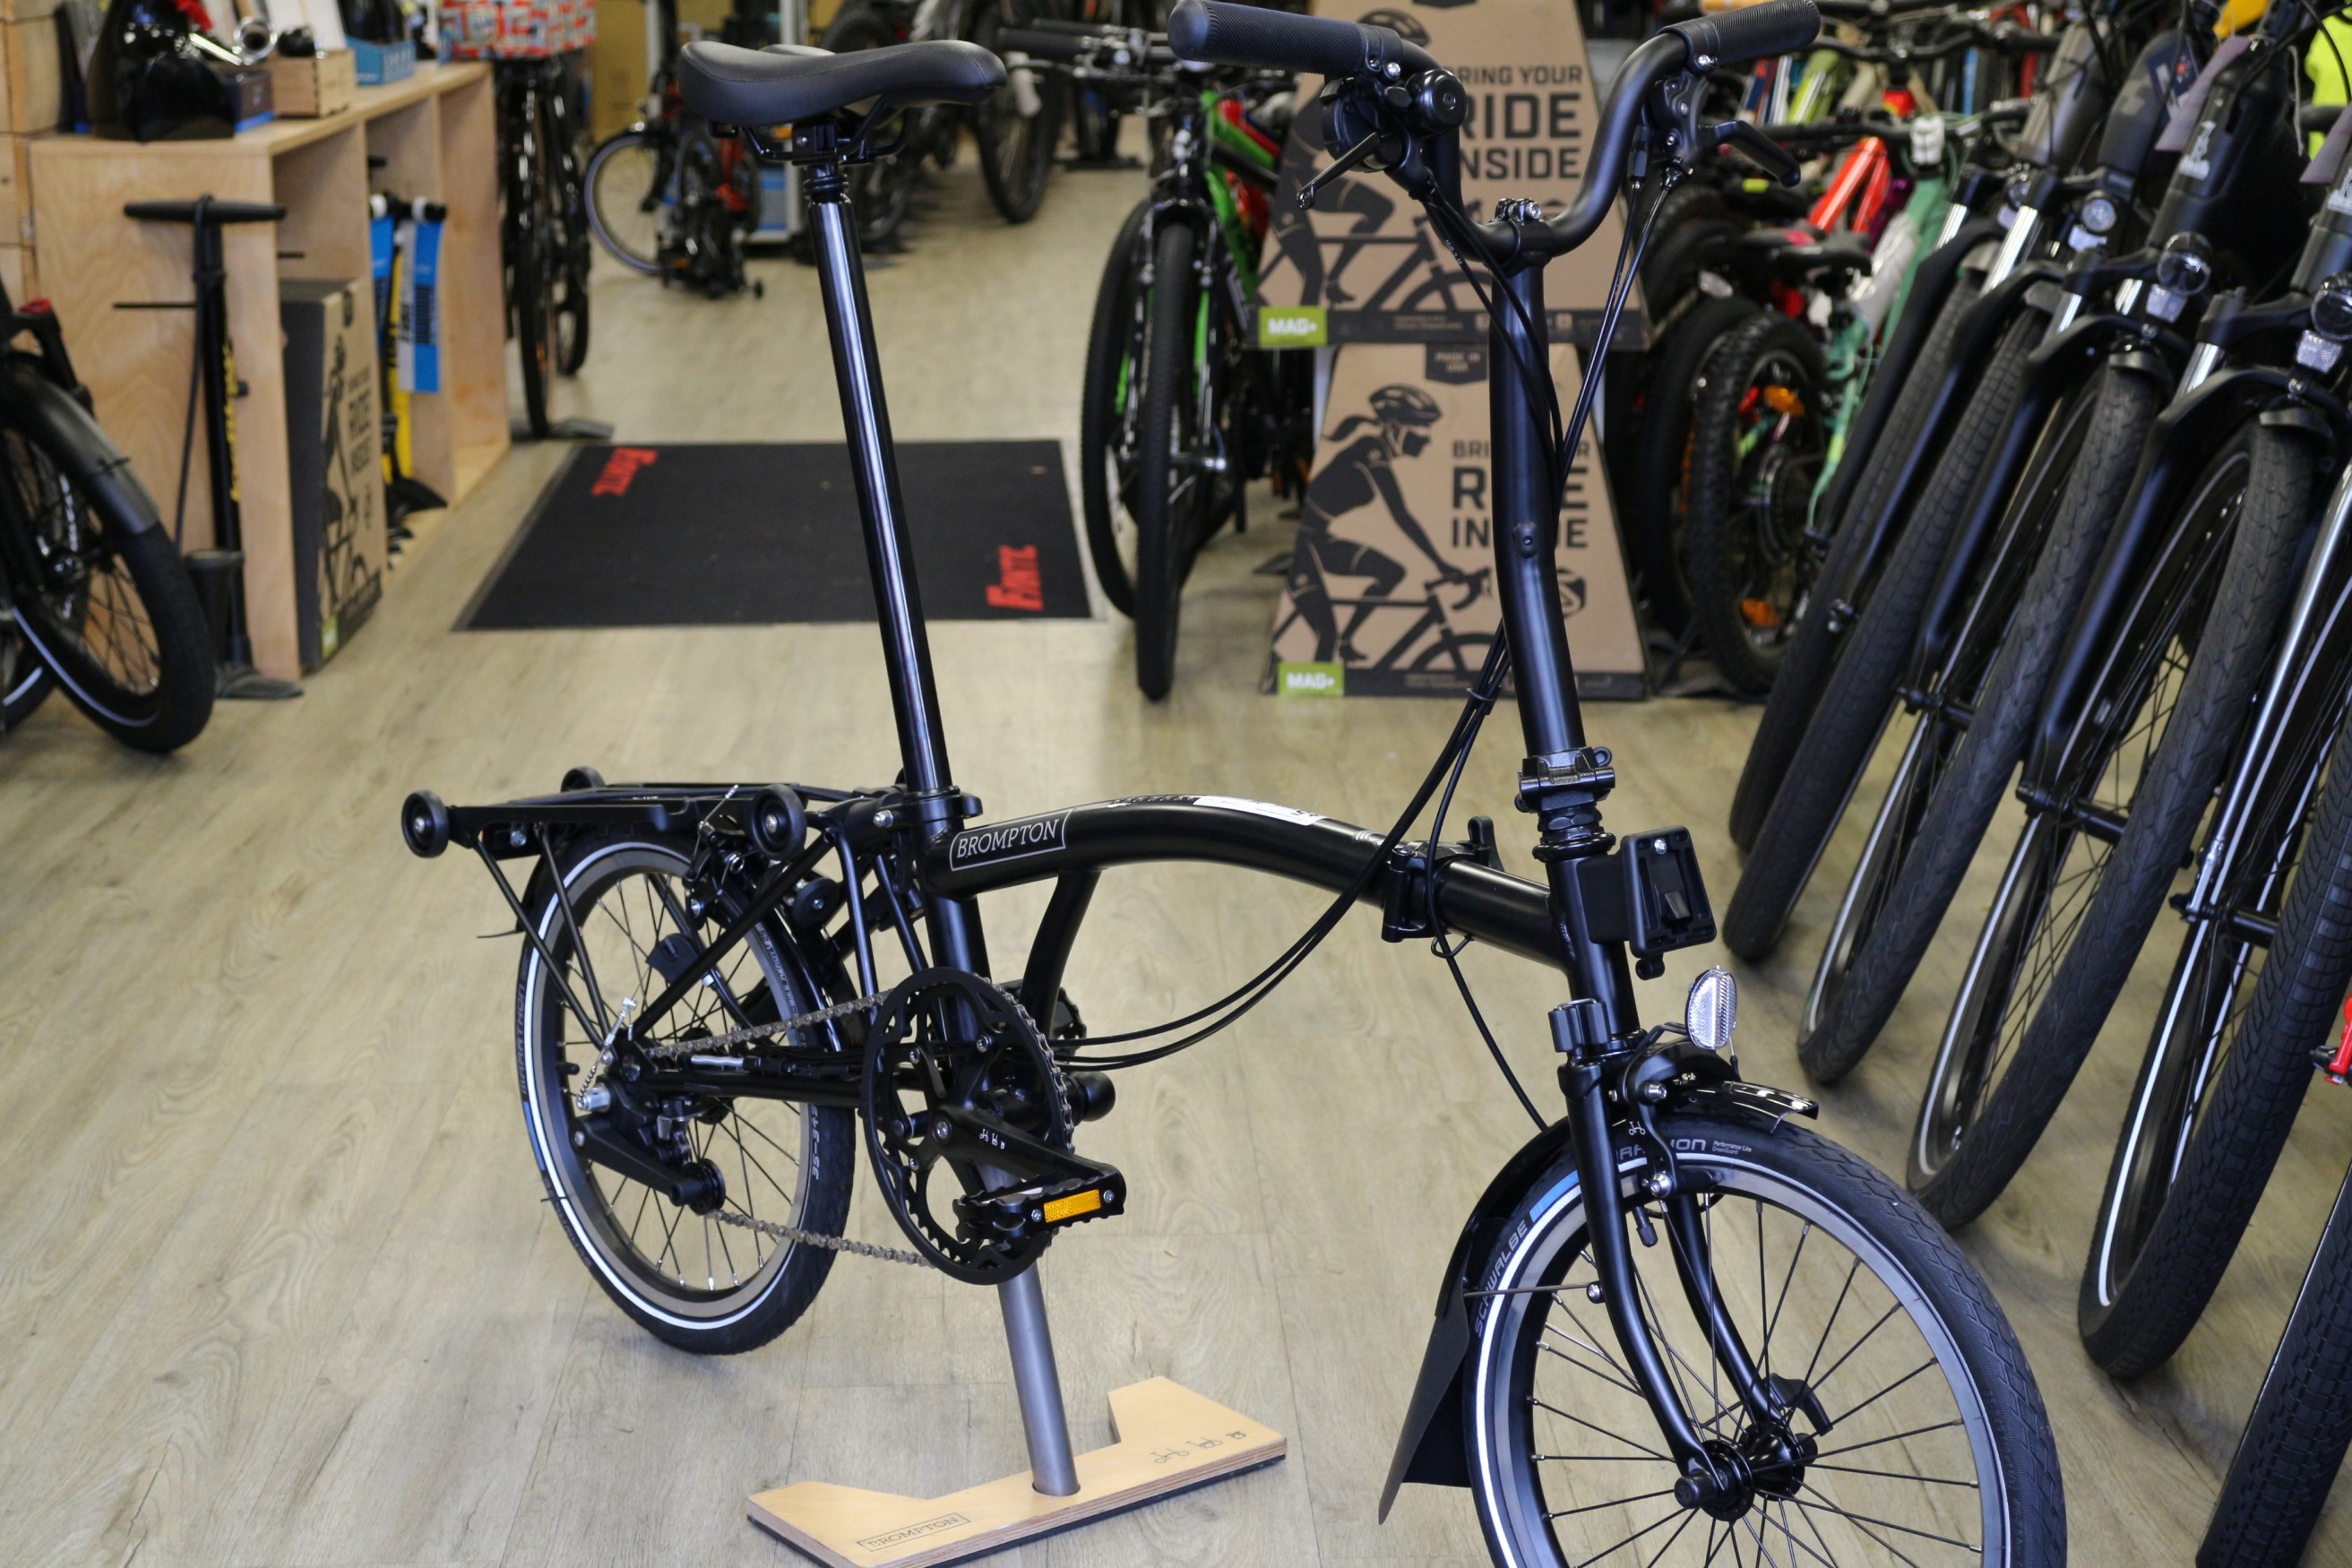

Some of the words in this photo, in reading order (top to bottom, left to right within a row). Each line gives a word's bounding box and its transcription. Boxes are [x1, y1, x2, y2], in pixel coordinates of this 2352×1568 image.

[1451, 66, 1512, 84] RING
[1519, 66, 1582, 84] YOUR
[1460, 148, 1581, 179] NSIDE
[957, 818, 1060, 858] BROMPTON
[1475, 1219, 1528, 1338] SCHWALBE
[867, 1516, 960, 1547] BROMPTON
